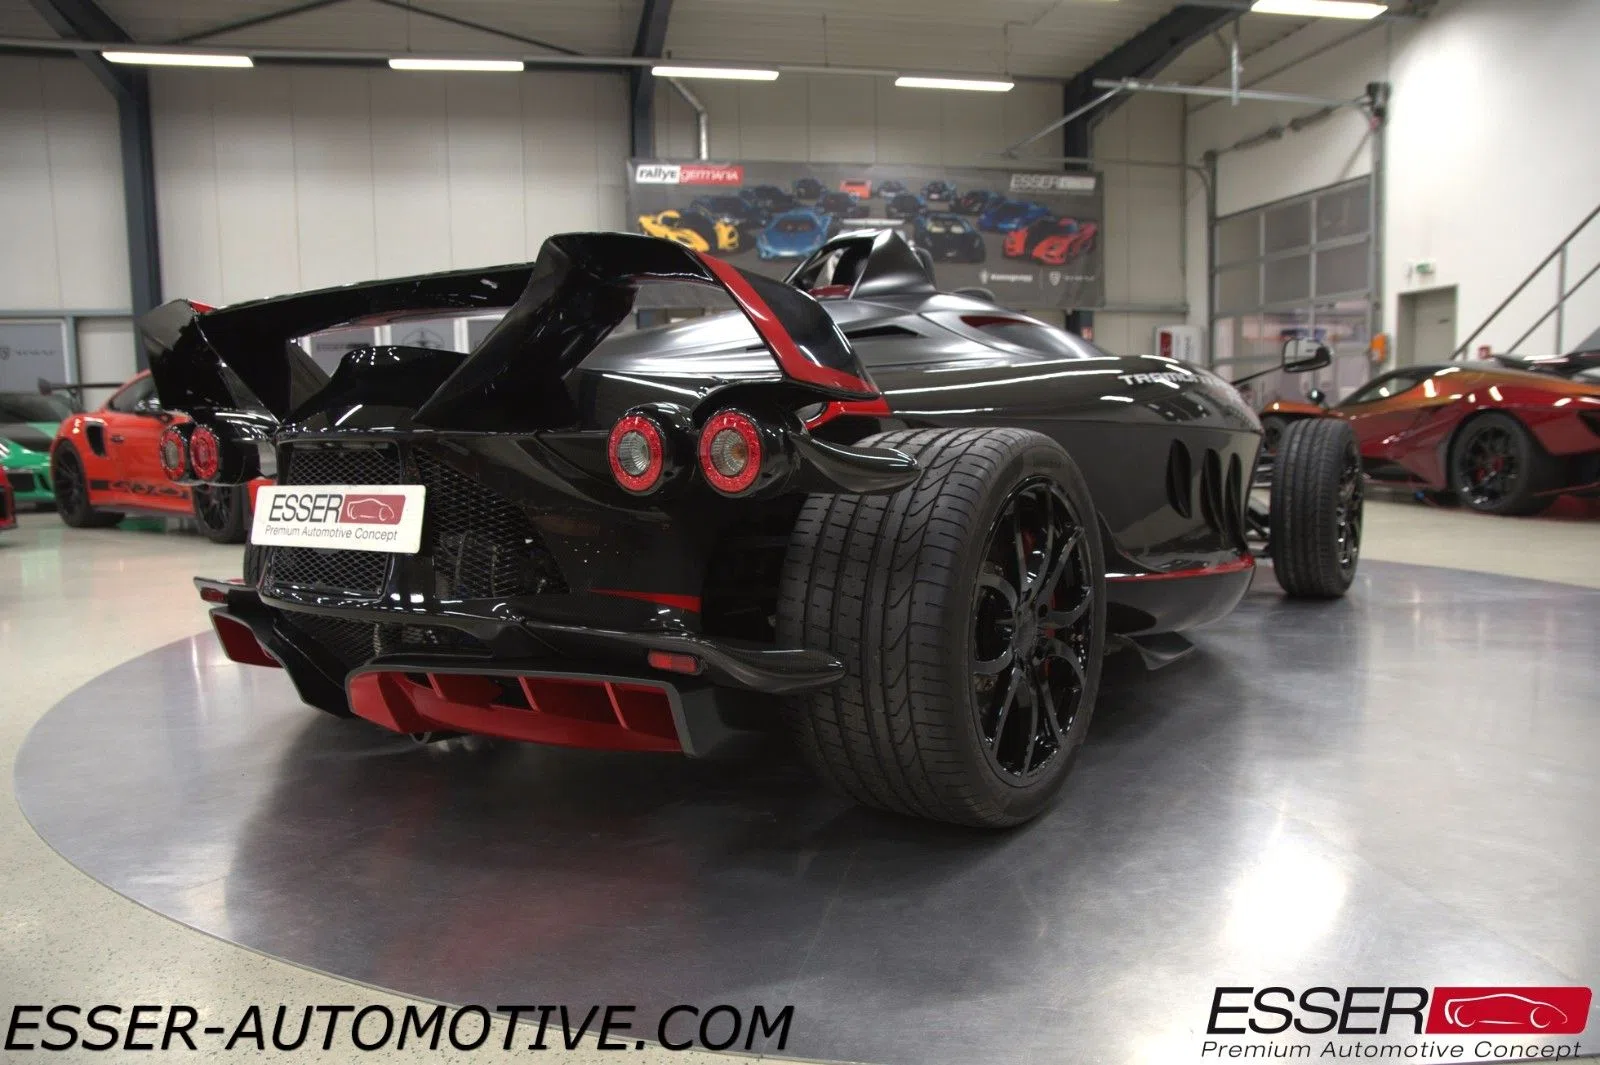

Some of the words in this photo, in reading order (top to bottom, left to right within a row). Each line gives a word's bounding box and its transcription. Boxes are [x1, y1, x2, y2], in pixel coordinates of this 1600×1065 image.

[269, 494, 343, 523] ESSER
[265, 525, 300, 536] Premium
[302, 527, 352, 538] Automotive
[355, 528, 397, 541] Concept
